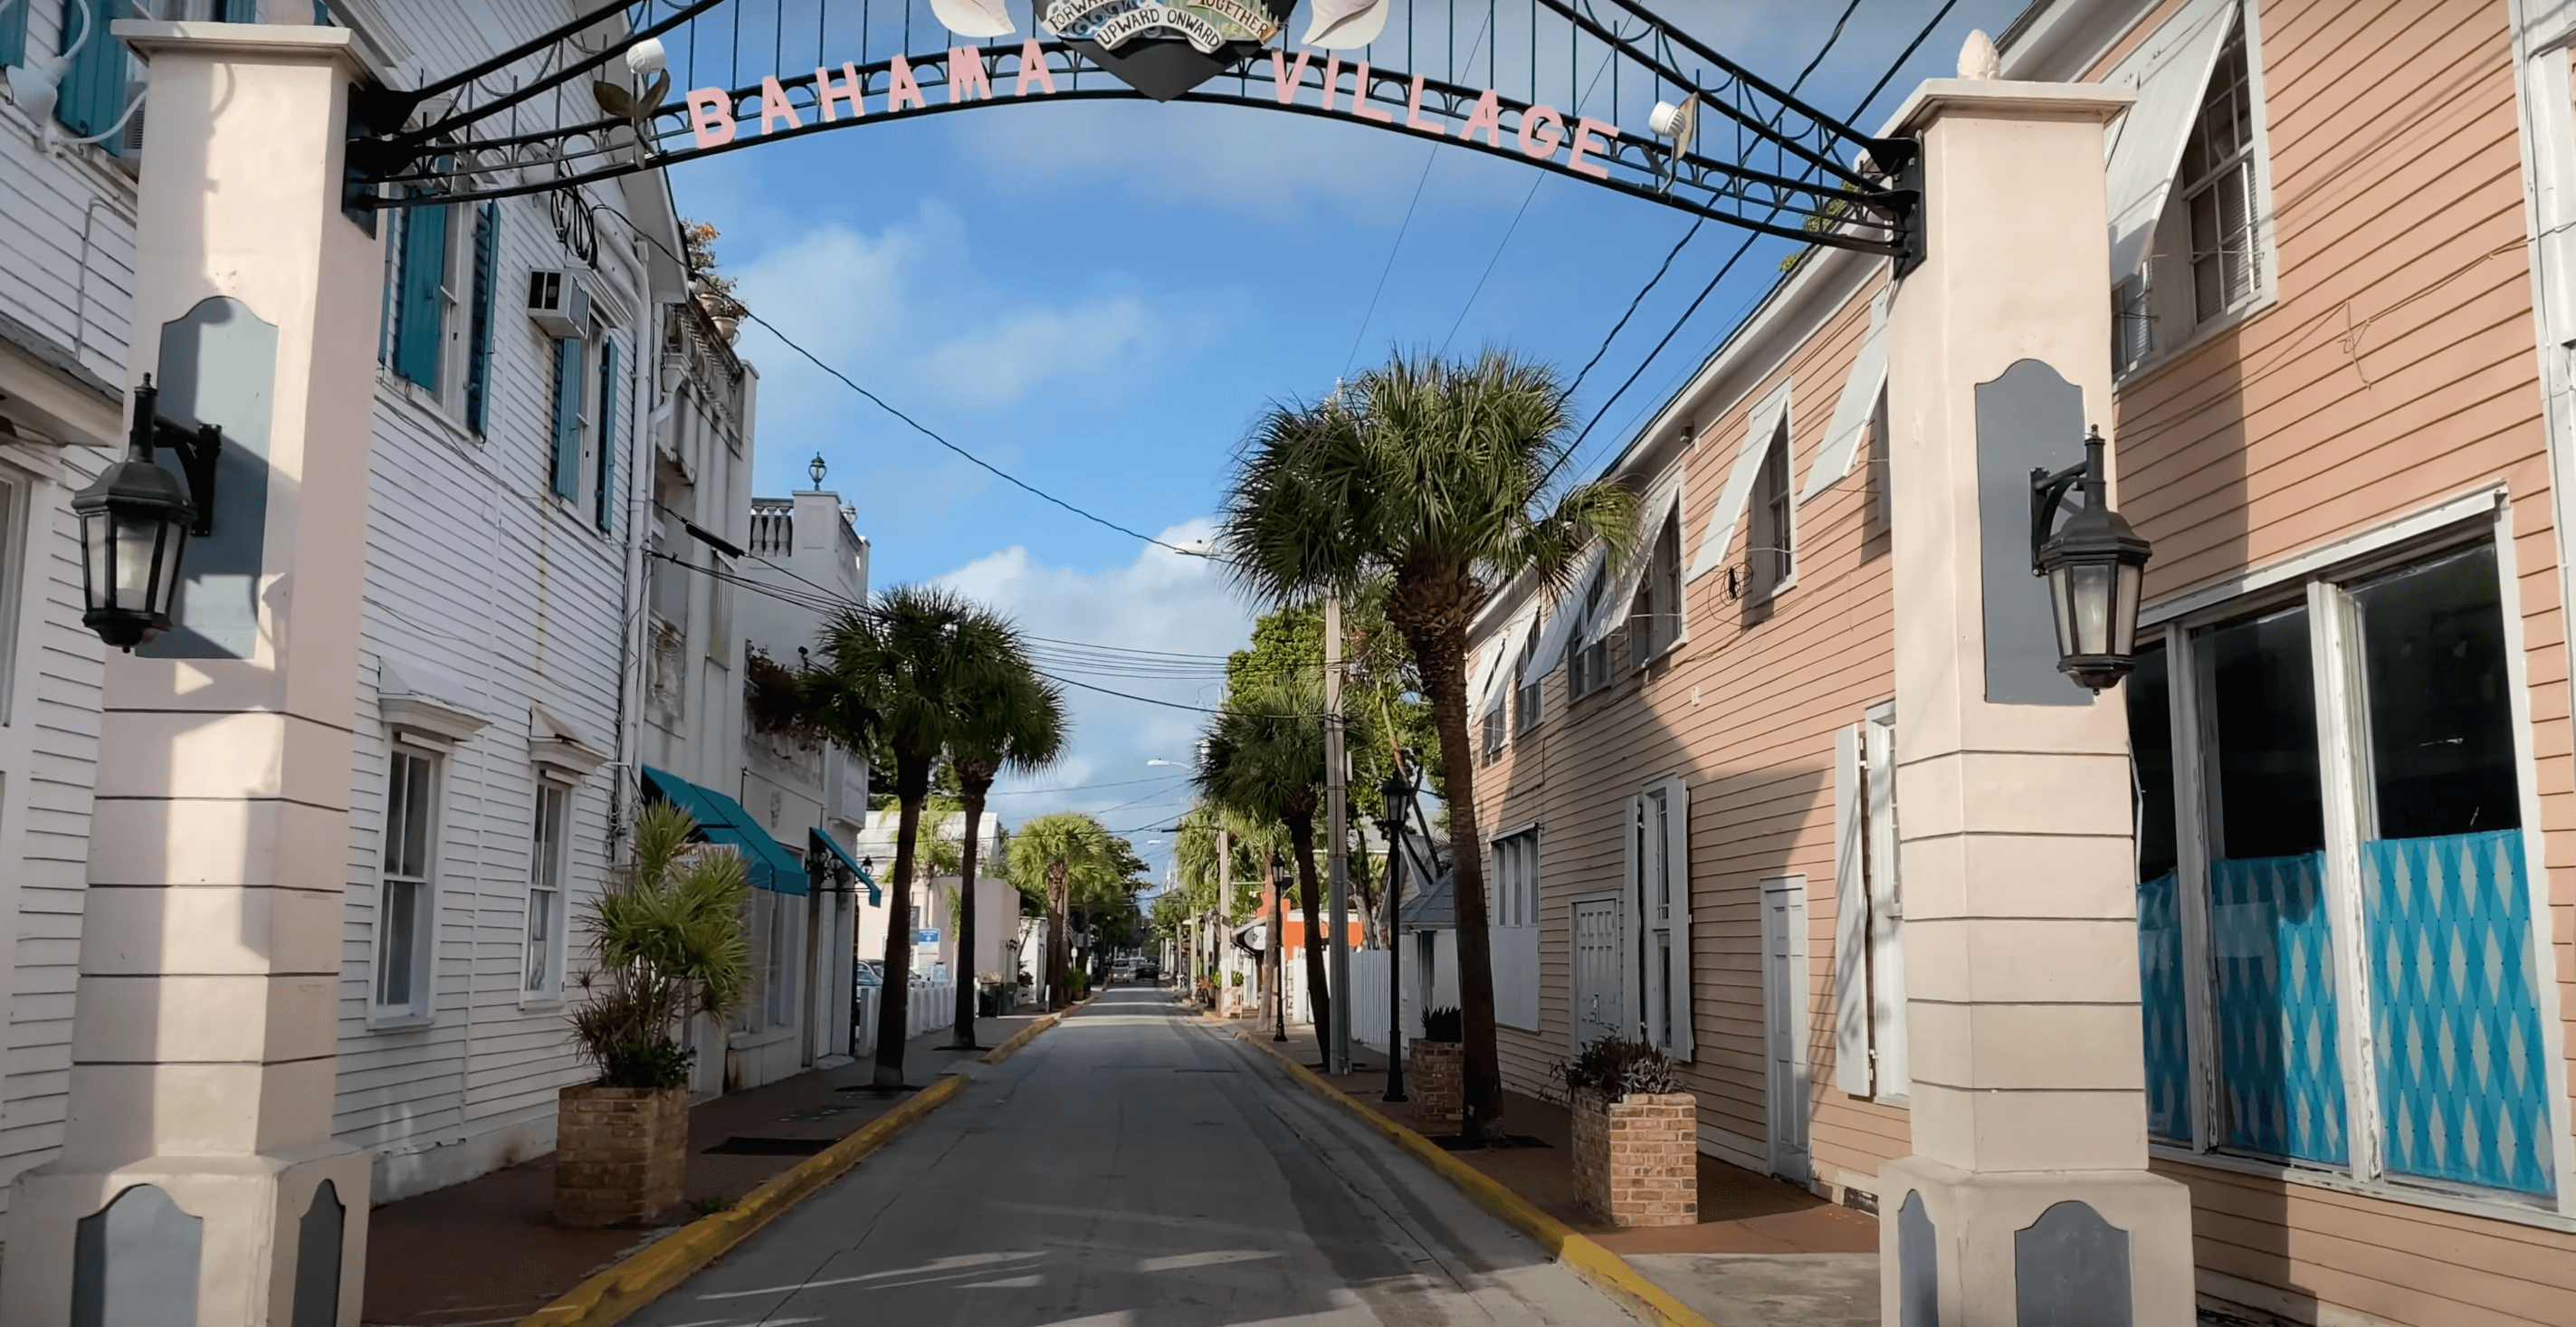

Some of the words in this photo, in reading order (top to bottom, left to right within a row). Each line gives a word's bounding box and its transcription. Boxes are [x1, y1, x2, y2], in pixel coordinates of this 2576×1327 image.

[1048, 0, 1103, 30] FORW
[1097, 8, 1159, 44] UPWARD
[1167, 9, 1220, 47] ONWARD
[685, 38, 1056, 149] BAHAMA
[1272, 48, 1619, 179] VILLAGE
